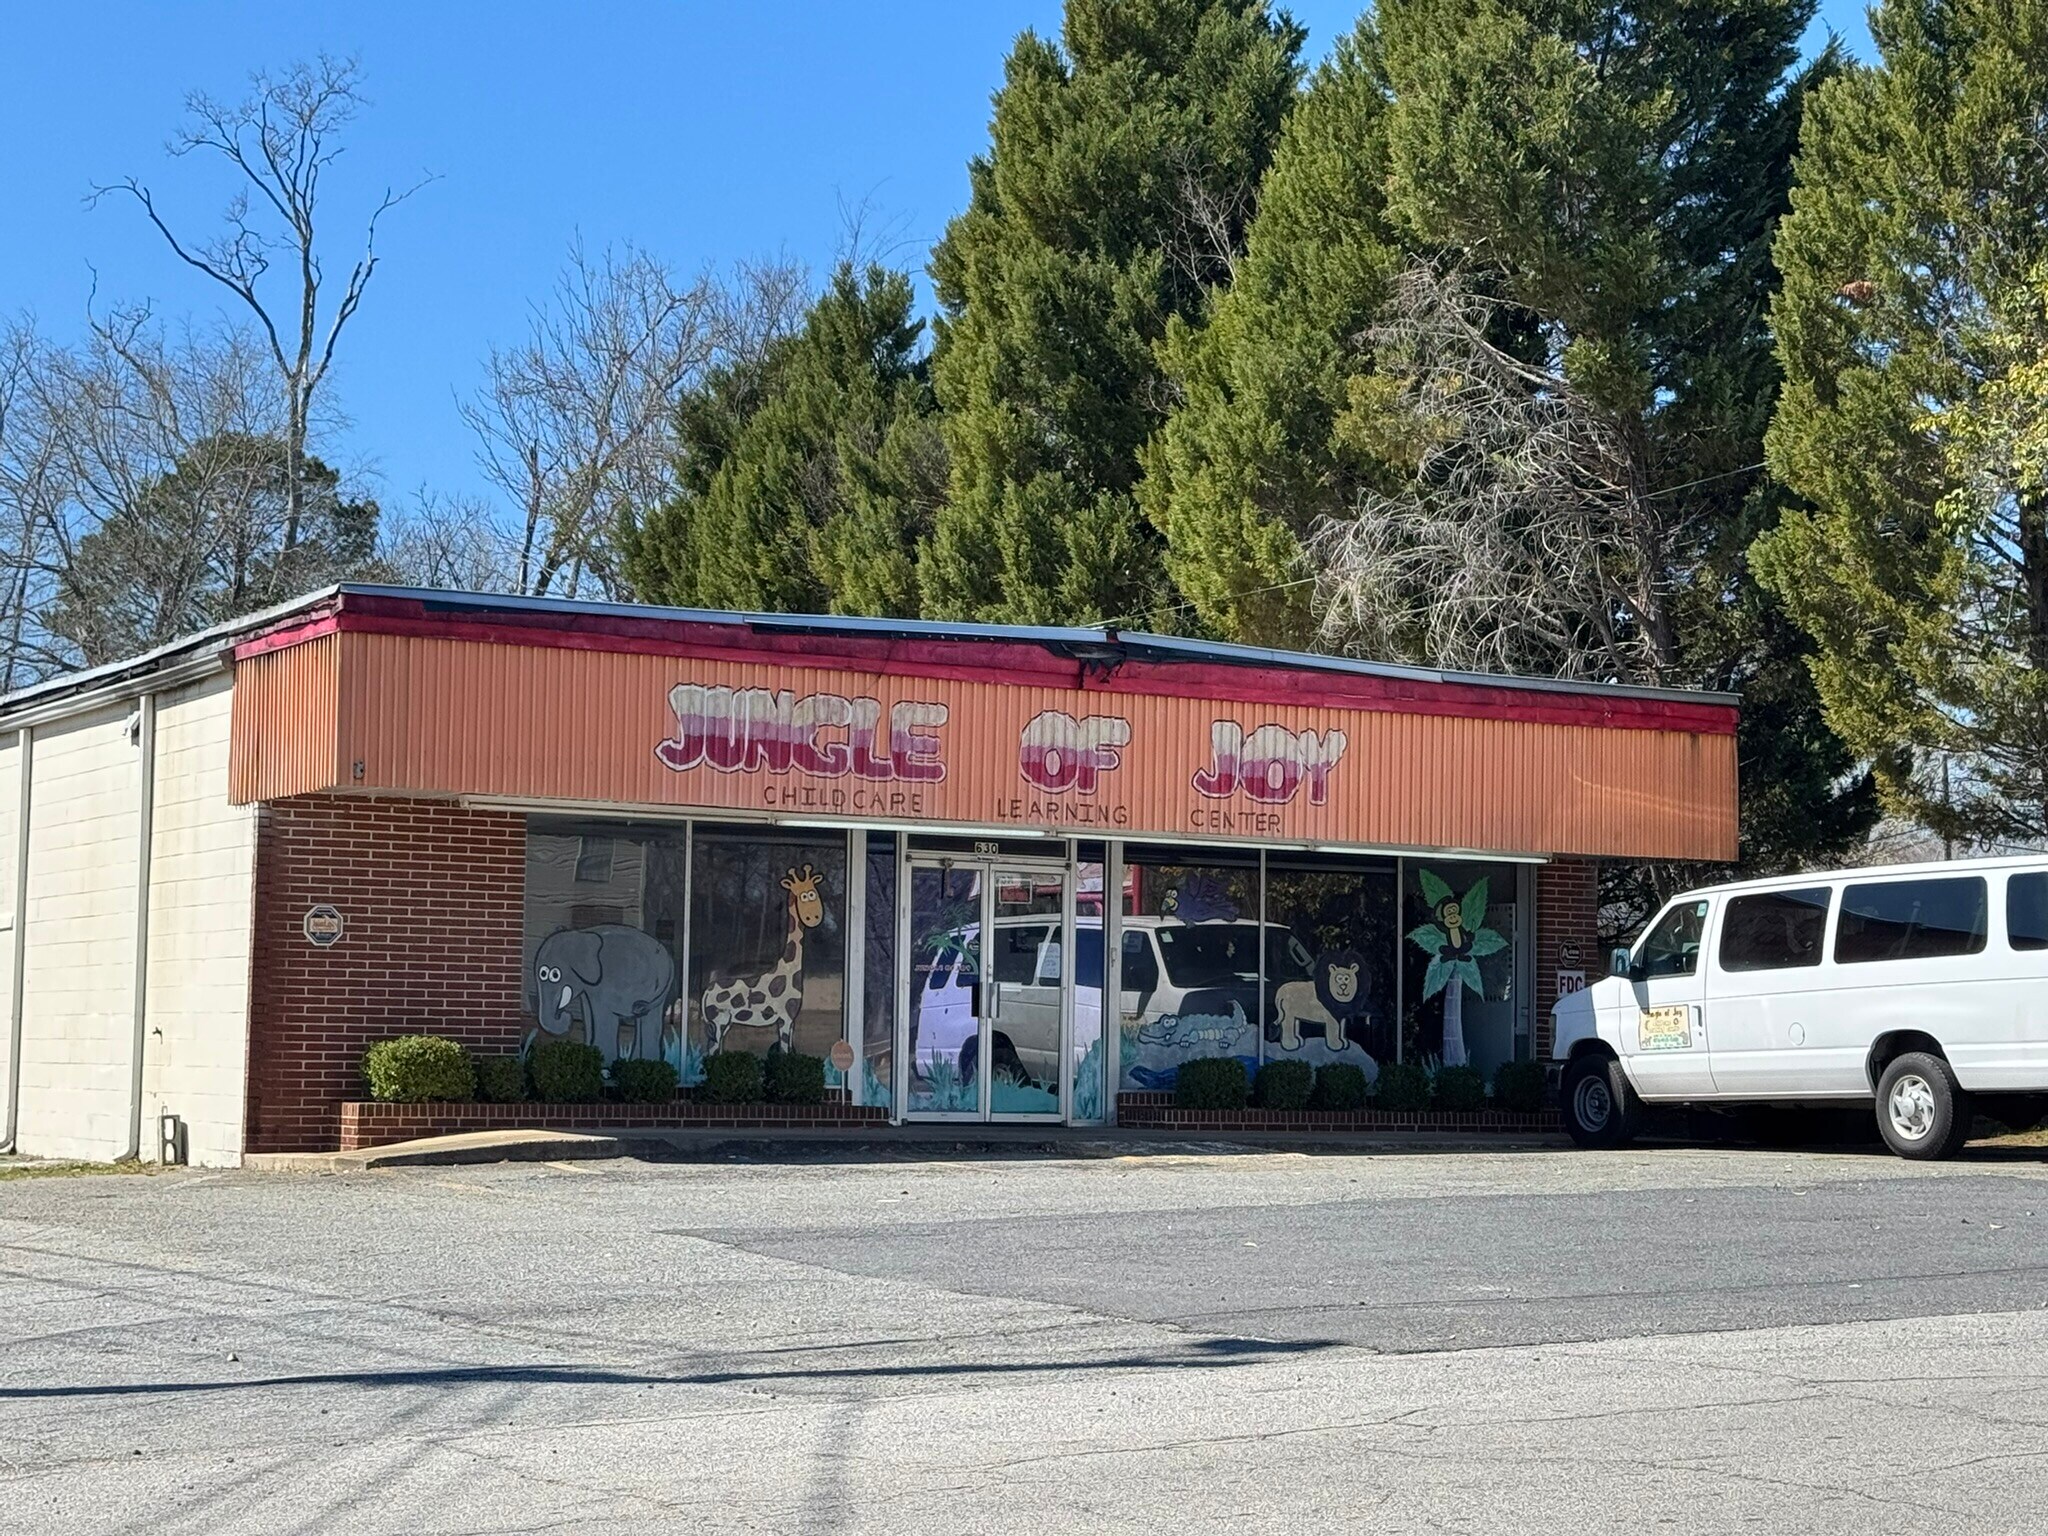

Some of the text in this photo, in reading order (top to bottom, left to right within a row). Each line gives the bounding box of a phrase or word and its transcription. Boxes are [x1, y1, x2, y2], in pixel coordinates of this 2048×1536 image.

[655, 682, 1348, 806] JUNGLE OF JOY
[997, 798, 1128, 824] LEARNING
[1190, 809, 1281, 833] CENTER
[976, 843, 998, 854] 630
[1560, 976, 1583, 993] FDC
